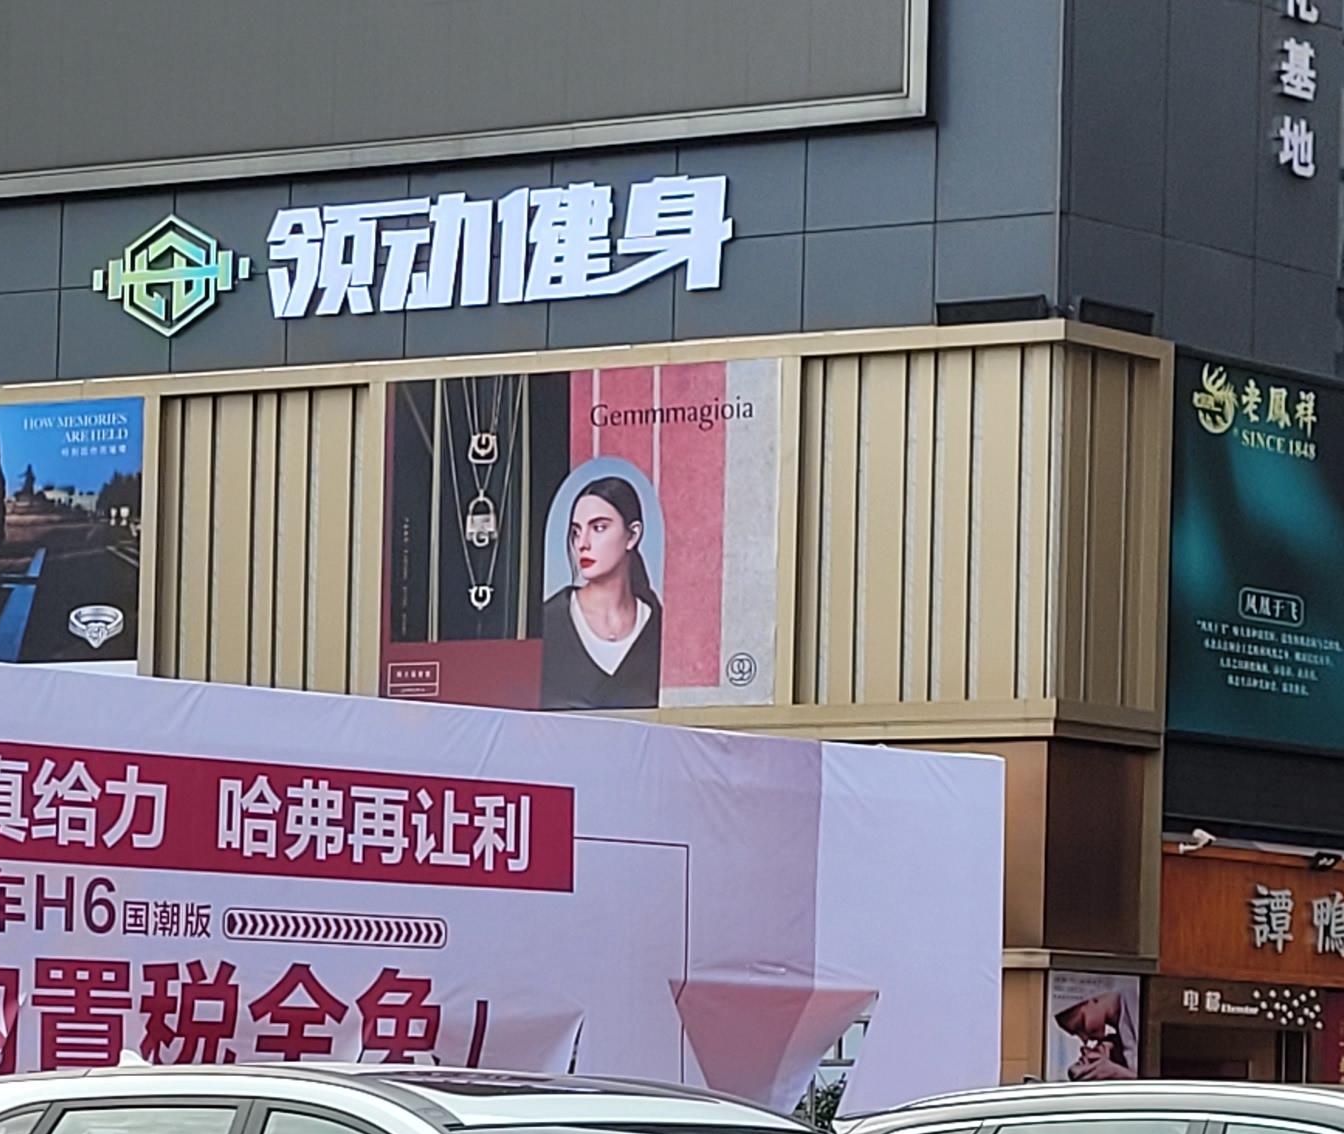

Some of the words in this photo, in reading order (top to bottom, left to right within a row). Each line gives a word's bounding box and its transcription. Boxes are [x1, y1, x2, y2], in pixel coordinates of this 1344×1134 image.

[266, 174, 733, 319] 领动健身
[23, 415, 54, 430] HOW
[590, 395, 754, 432] Gemmmagioia
[1241, 378, 1317, 438] 老鳳祥
[90, 427, 129, 441] HELD
[1241, 428, 1286, 455] SINCE
[1288, 439, 1317, 461] 1848
[217, 775, 531, 871] 哈弗再让利
